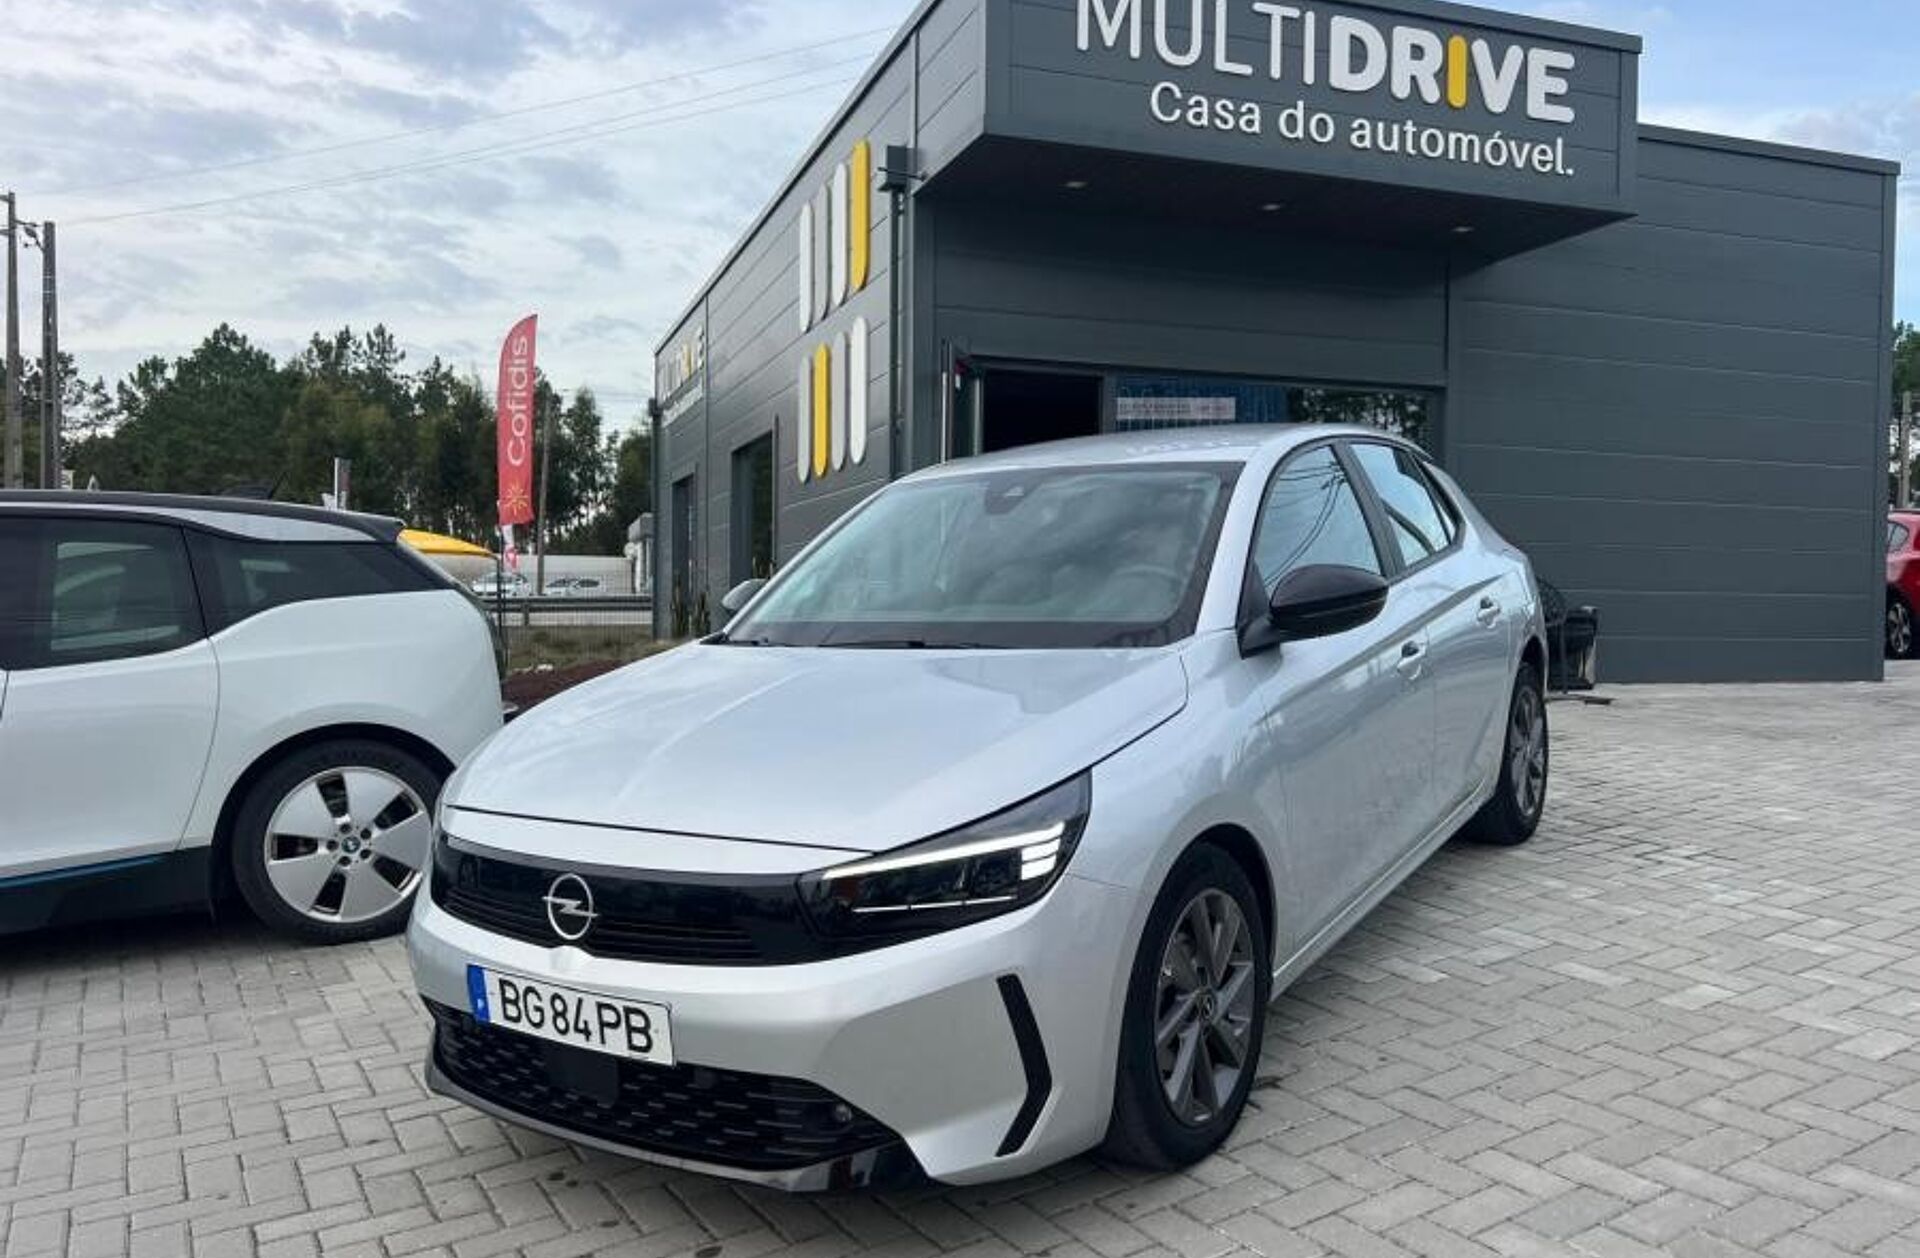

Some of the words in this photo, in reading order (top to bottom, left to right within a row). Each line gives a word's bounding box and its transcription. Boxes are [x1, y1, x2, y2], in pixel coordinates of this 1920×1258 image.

[1151, 81, 1262, 134] Casa
[1279, 101, 1335, 143] do
[1350, 117, 1575, 176] automóvel.
[507, 336, 528, 467] Cofidis
